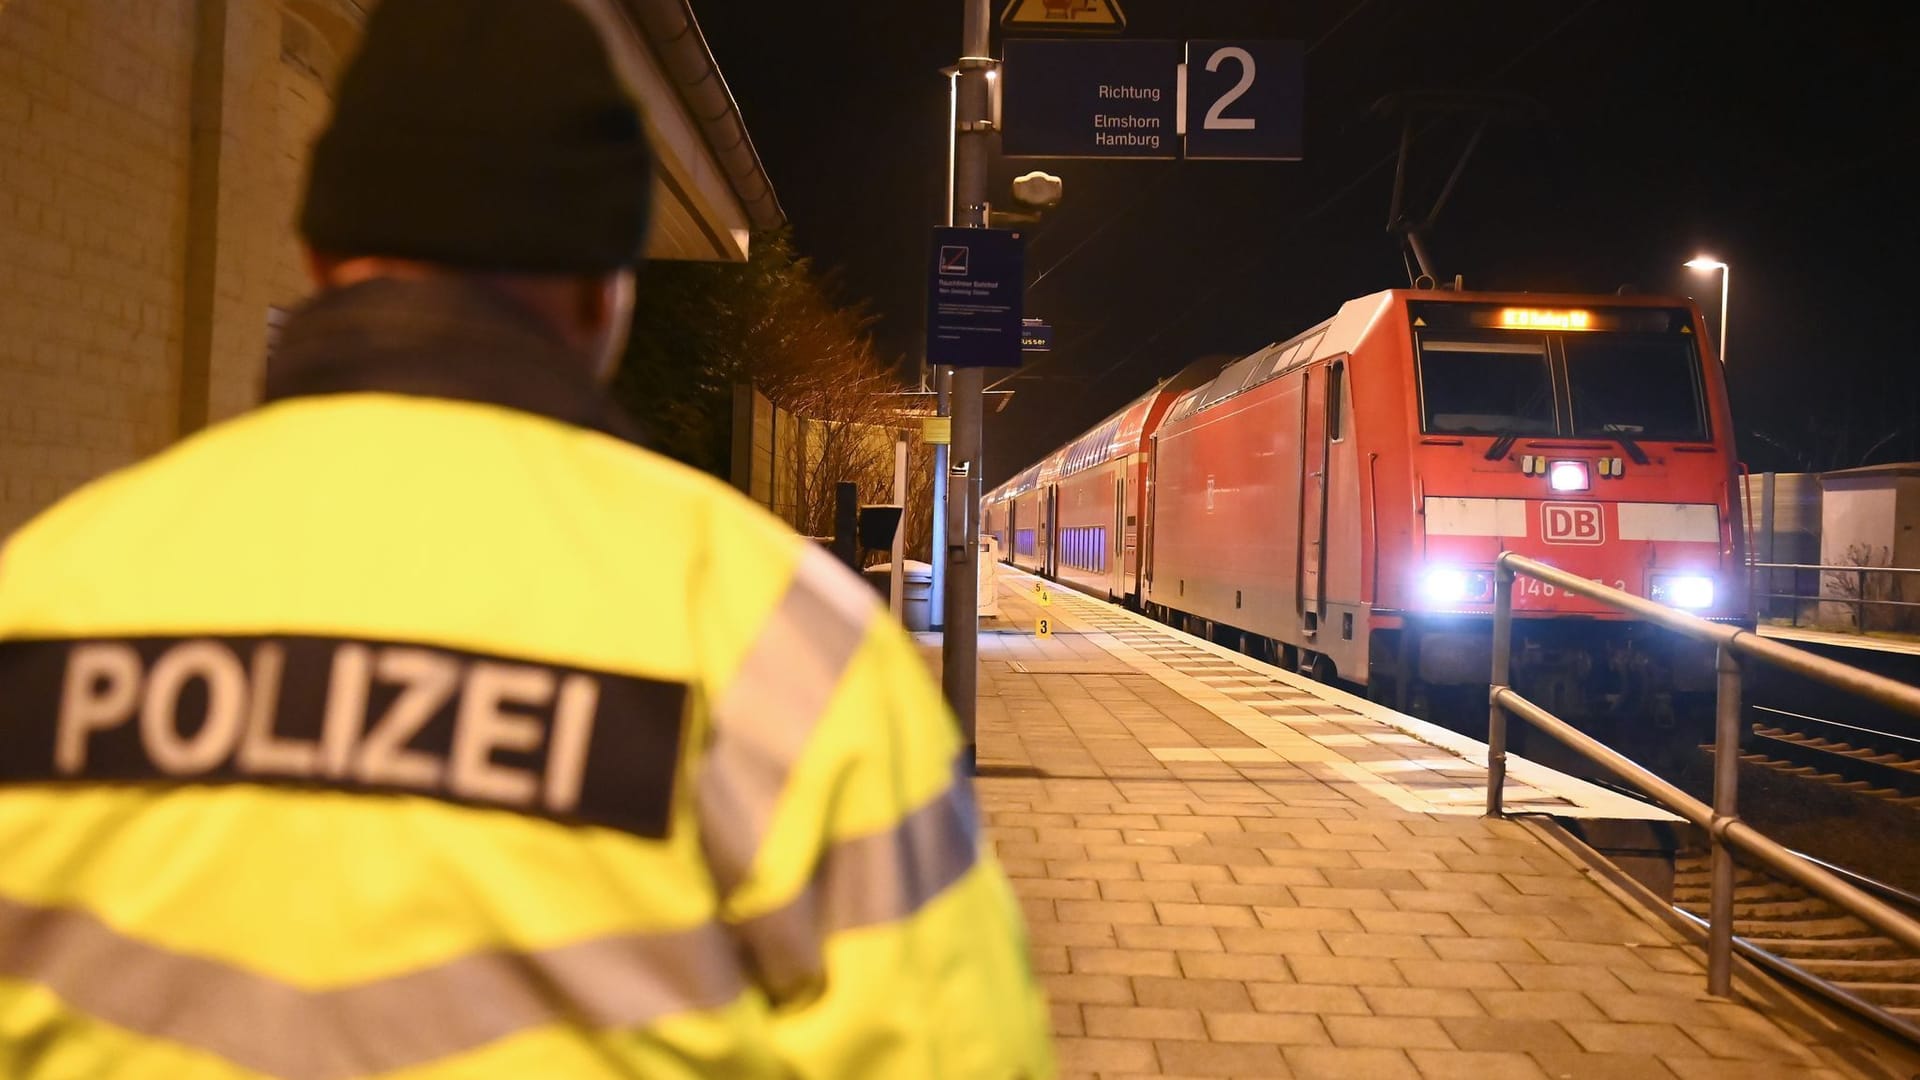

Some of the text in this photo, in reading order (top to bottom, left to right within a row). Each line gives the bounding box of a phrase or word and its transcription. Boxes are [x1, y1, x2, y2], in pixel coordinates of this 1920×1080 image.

[1098, 85, 1161, 101] Richtung
[1203, 46, 1257, 130] 2
[1094, 114, 1161, 129] Elmshorn
[1095, 132, 1160, 148] Hamburg
[1550, 509, 1597, 537] DB
[1040, 620, 1047, 633] 3
[54, 639, 599, 812] POLIZEI
